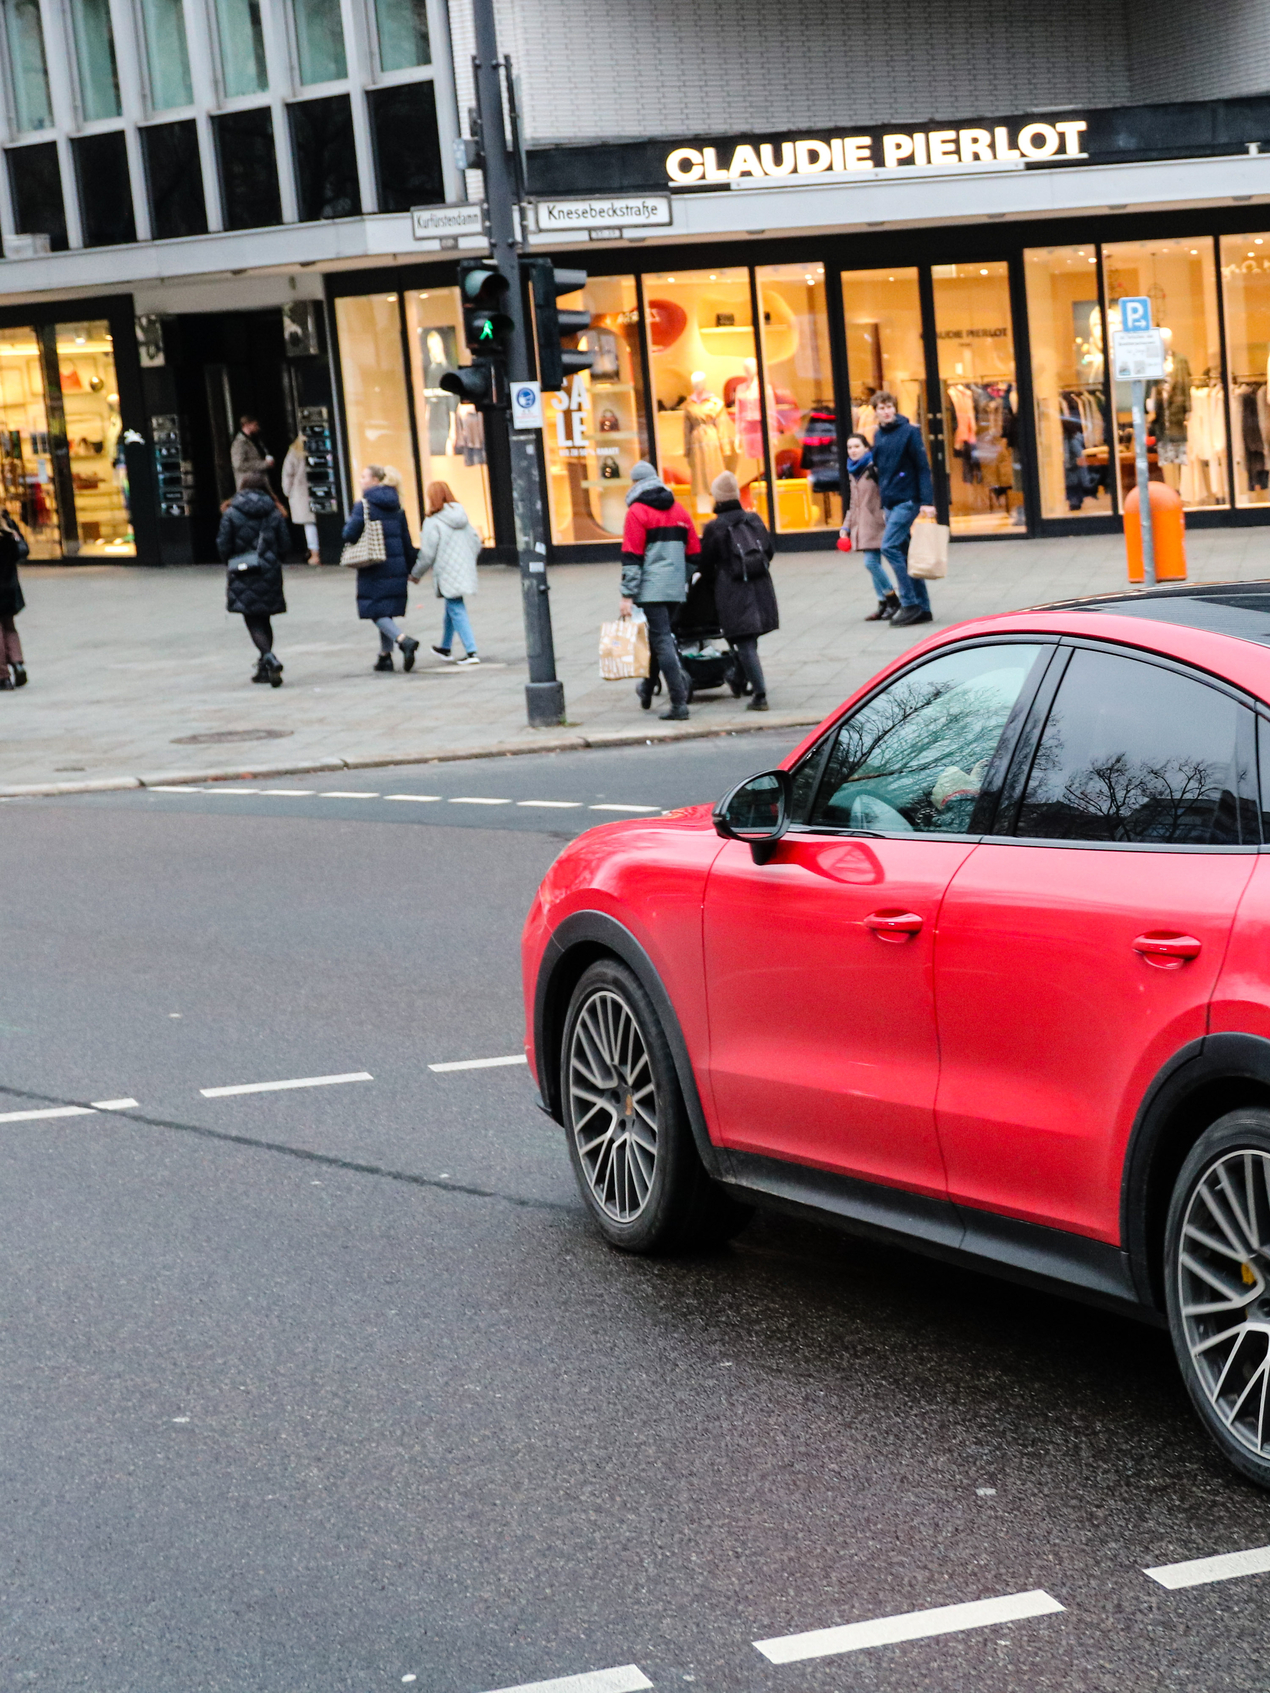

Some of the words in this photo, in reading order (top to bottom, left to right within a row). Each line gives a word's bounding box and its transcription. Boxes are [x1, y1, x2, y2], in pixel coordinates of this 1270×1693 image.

[665, 136, 873, 182] CLAUDIE
[882, 120, 1088, 168] PIERLOT
[416, 213, 480, 229] Kurfürstendamm
[547, 201, 659, 220] Knesebeckstraße
[1126, 302, 1144, 328] P
[556, 411, 590, 446] LE
